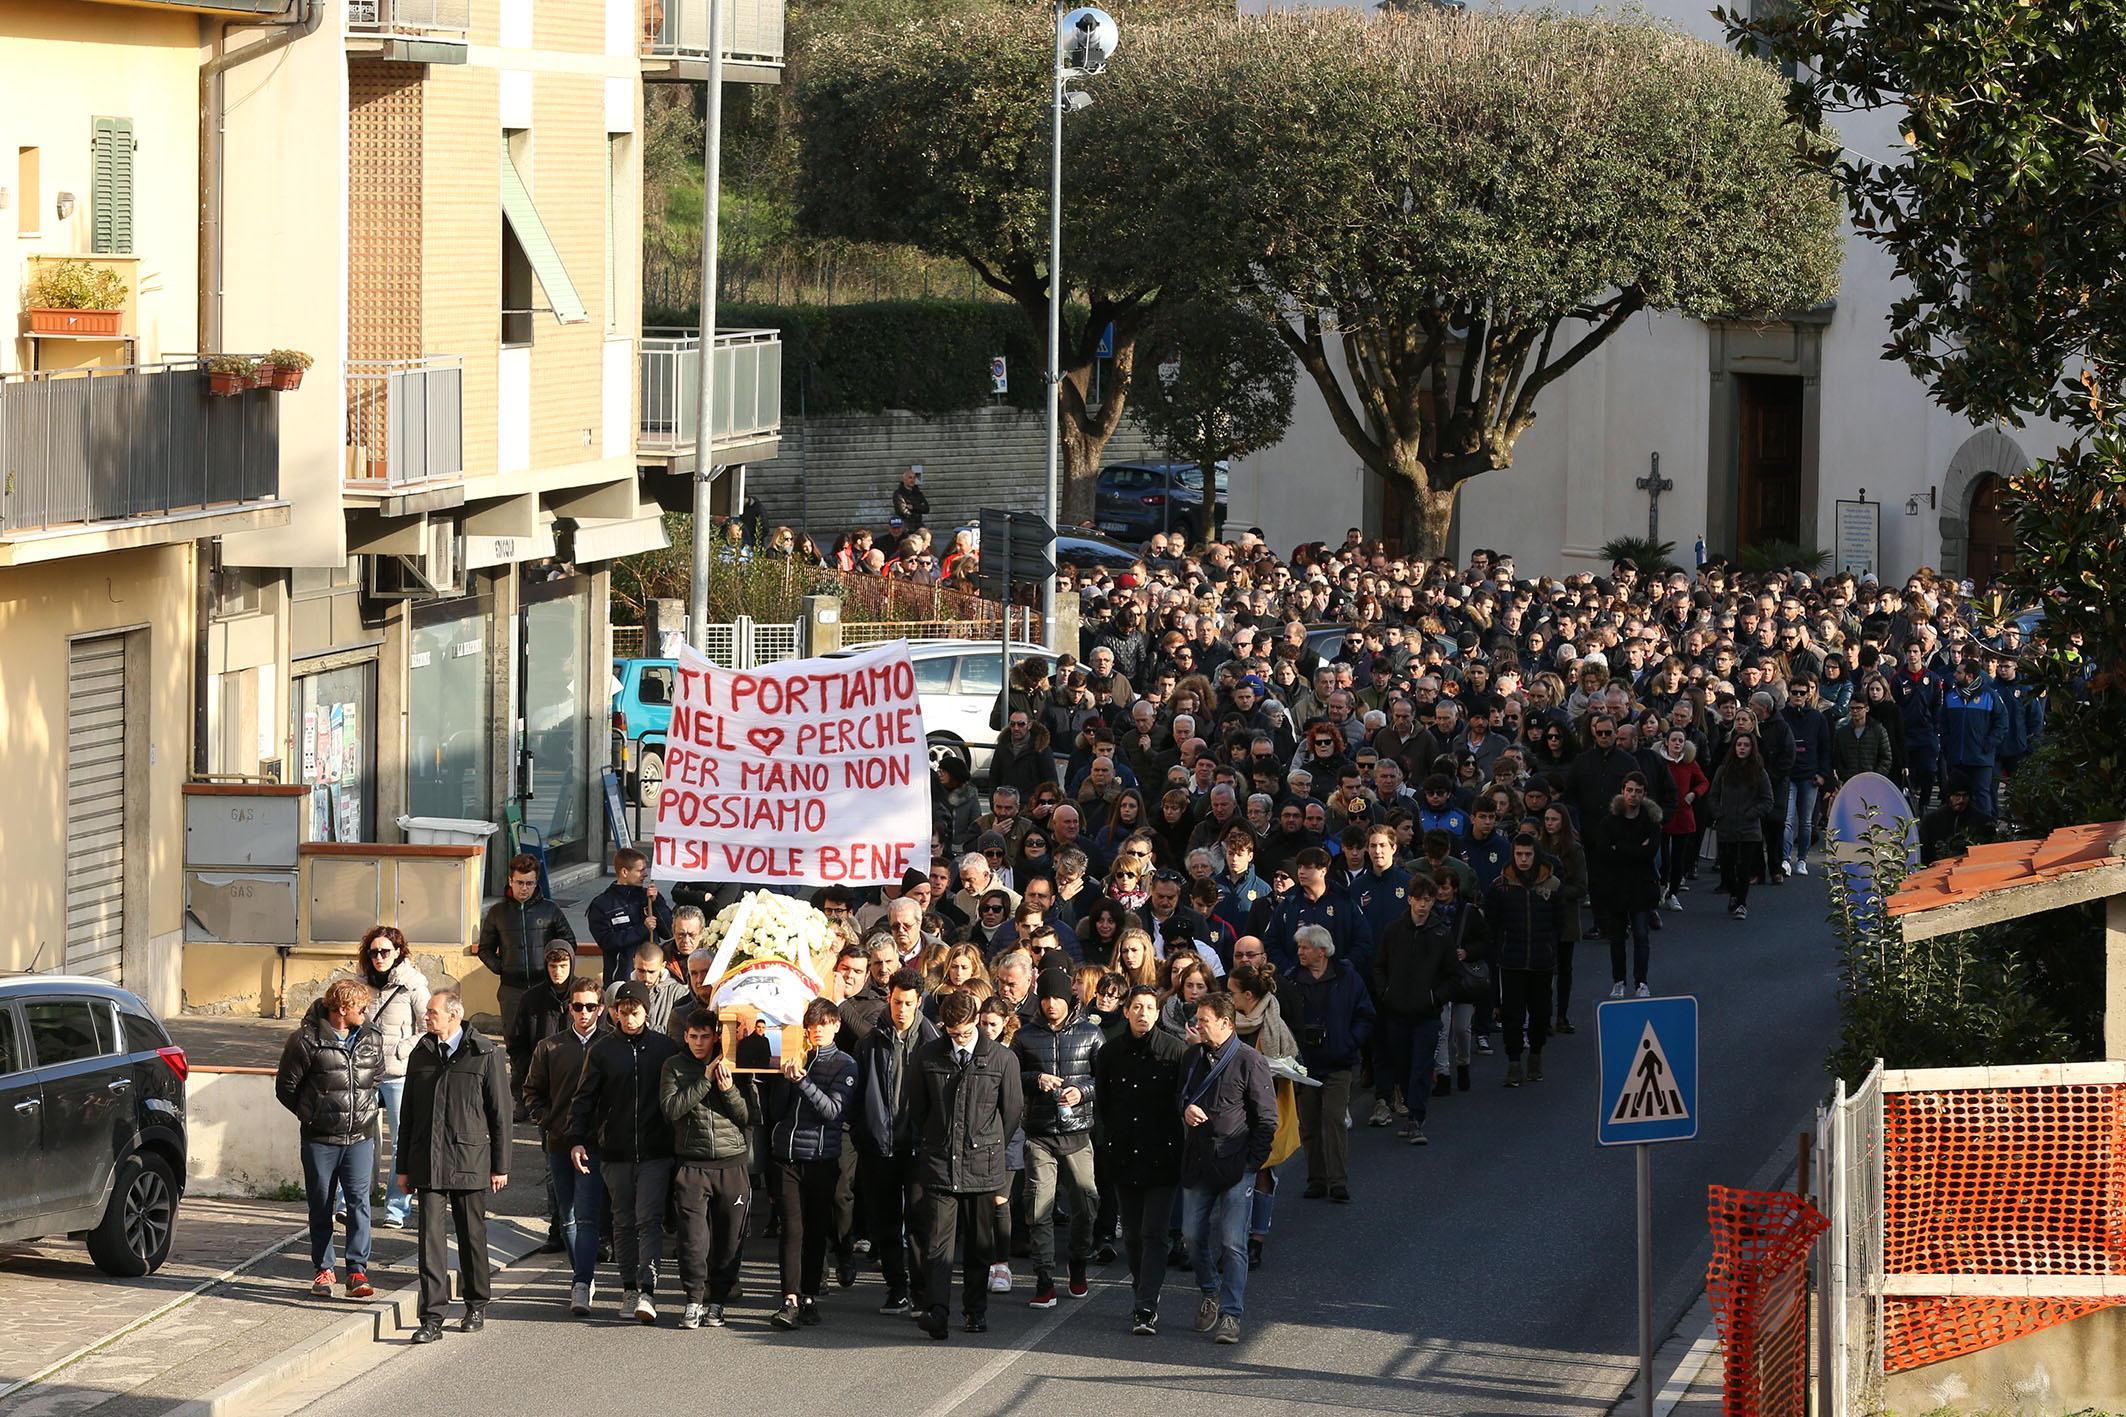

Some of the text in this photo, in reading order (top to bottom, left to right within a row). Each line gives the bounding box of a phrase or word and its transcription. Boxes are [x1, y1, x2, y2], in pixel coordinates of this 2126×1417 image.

[677, 660, 915, 715] TI PORTIAMO
[672, 704, 921, 756] NEL PERCHE'
[664, 746, 910, 793] PER MANO NON
[231, 808, 254, 823] GAS
[657, 787, 827, 833] POSSIAMO
[654, 836, 916, 881] TI SI VOLE BENE
[230, 885, 253, 898] GAS
